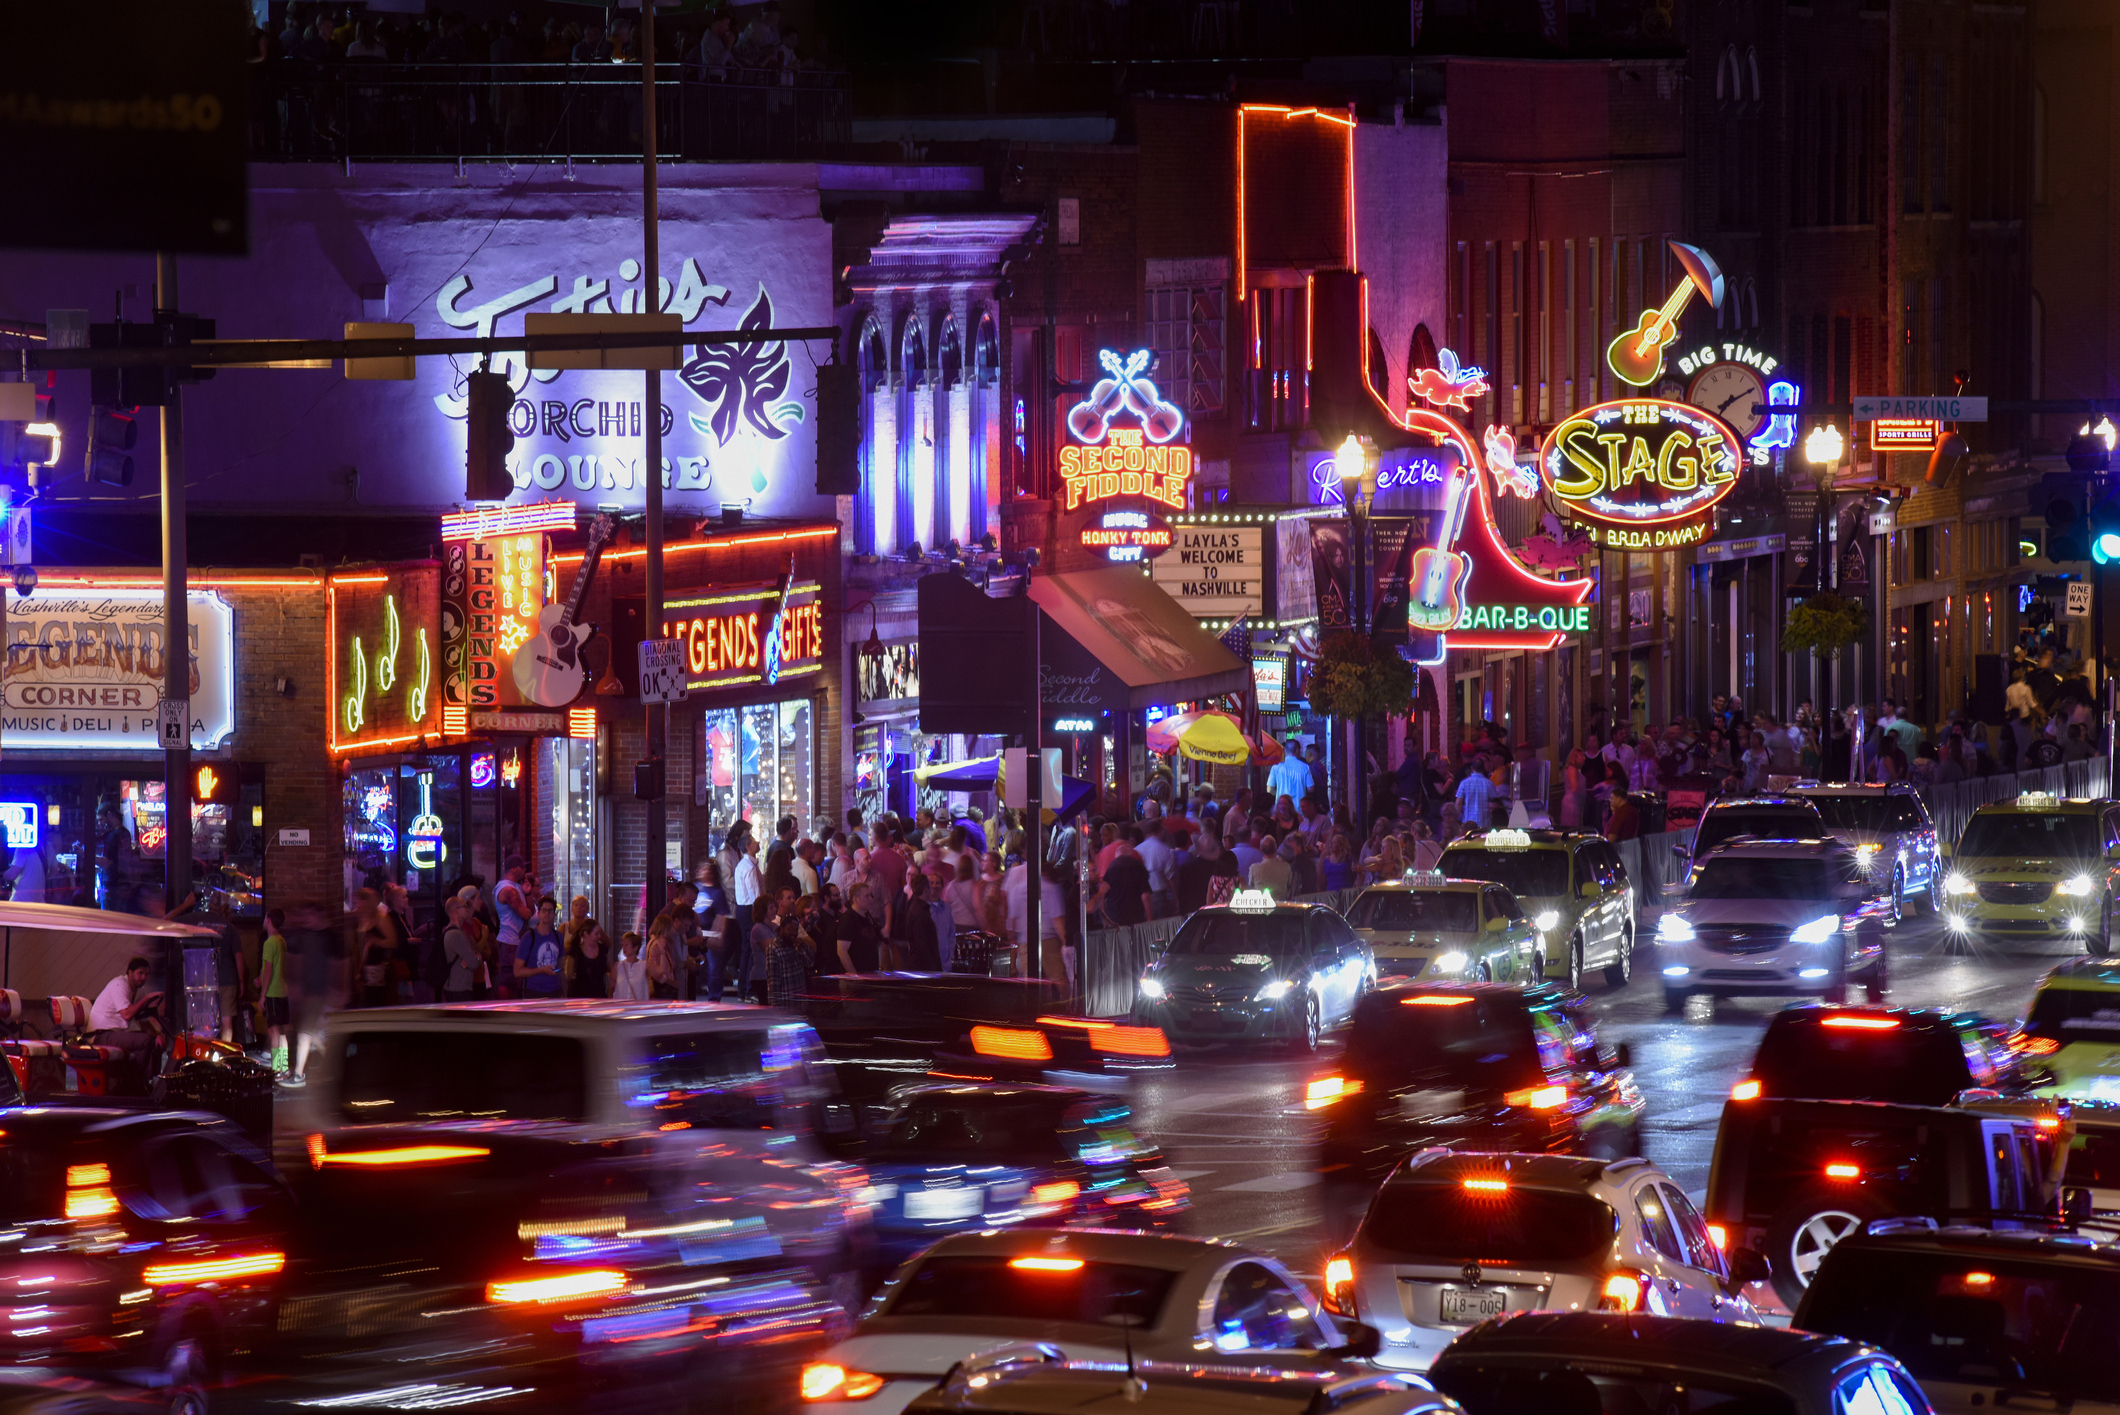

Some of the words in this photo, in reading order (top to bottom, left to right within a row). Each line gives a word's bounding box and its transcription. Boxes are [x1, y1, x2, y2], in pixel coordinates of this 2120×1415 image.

[1678, 346, 1716, 375] BIG
[1723, 343, 1778, 375] TIME
[1623, 405, 1659, 424] THE
[1881, 400, 1960, 418] PARKING
[1108, 429, 1142, 446] THE
[1060, 445, 1192, 479] SECOND
[1553, 419, 1735, 500] STAGE
[1313, 458, 1443, 504] Rert's
[1067, 471, 1185, 510] FIDDLE
[1104, 512, 1147, 528] MUSIC
[1082, 531, 1127, 544] HONKY
[1132, 531, 1170, 545] TONK
[1185, 534, 1239, 547] LAYLA'S
[1608, 523, 1706, 547] BROADWAY
[1181, 550, 1244, 564] WELCOME
[1795, 553, 1809, 563] abc
[1841, 554, 1861, 562] CMA
[501, 540, 514, 608] LIVE
[516, 537, 533, 617] MUSIC
[1203, 566, 1218, 579] TO
[1842, 567, 1862, 580] 50
[1182, 582, 1246, 595] NASHVILLE
[2070, 585, 2089, 594] ONE
[1383, 592, 1398, 603] abc
[2069, 595, 2089, 603] WAY
[7, 598, 89, 615] Nashville's
[470, 542, 498, 704] LEGENDS
[1323, 608, 1347, 625] 50
[1461, 605, 1590, 630] BAR-B-QUE
[781, 603, 819, 662] GIFTS
[645, 642, 681, 655] DIAGONAL
[645, 654, 681, 668] CROSSING
[643, 672, 661, 695] OK
[1039, 664, 1101, 686] Second
[21, 687, 141, 706] CORNER
[2, 718, 56, 731] MUSIC
[73, 718, 111, 731] DELI
[142, 718, 205, 732] PIA
[473, 715, 561, 729] CORNER
[1055, 720, 1094, 731] ATM
[1189, 745, 1216, 757] Vienna
[1218, 751, 1237, 761] Beef
